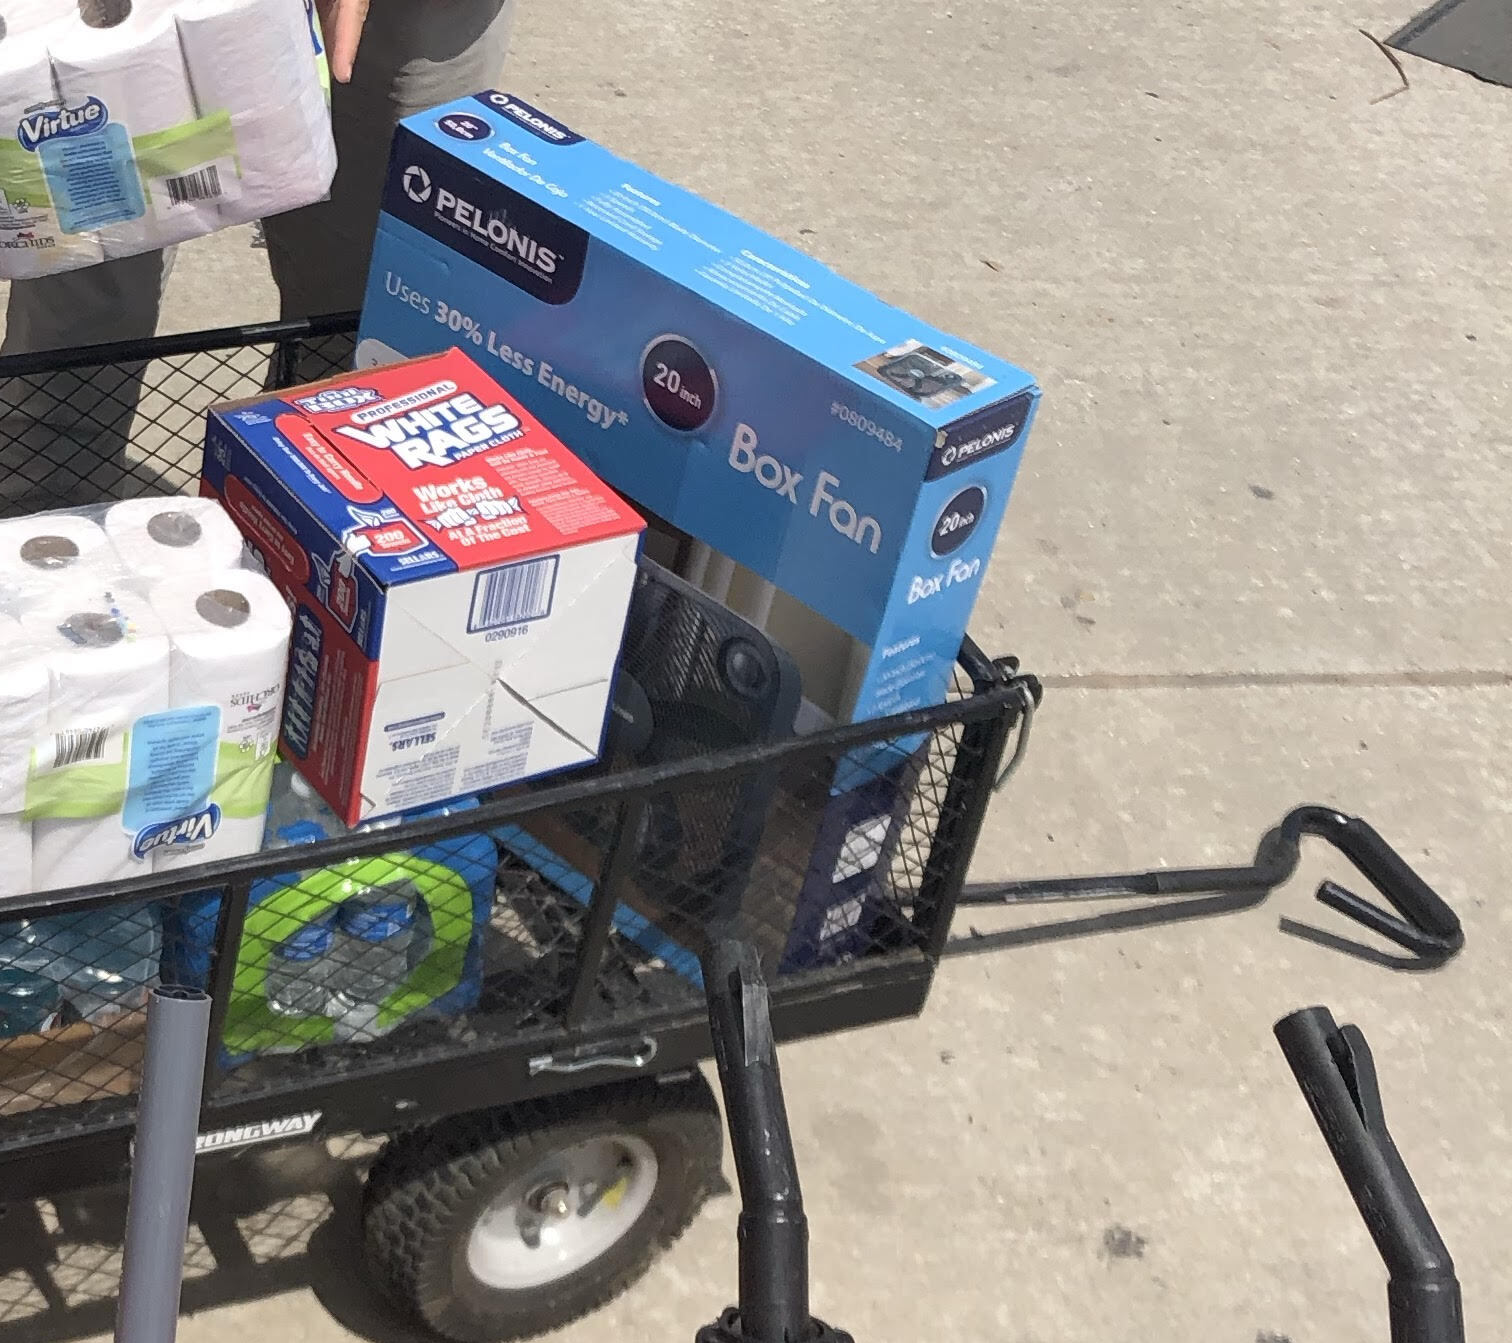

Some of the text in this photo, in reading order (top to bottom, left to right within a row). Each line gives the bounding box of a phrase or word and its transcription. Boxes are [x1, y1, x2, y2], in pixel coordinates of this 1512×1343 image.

[21, 105, 101, 143] Virtue
[505, 103, 567, 141] PELONIS
[436, 187, 557, 274] PELONIS
[385, 270, 432, 315] Uses
[434, 300, 484, 346] 30%
[487, 330, 536, 376] Less
[357, 383, 454, 422] PROFESSIONAL
[652, 361, 702, 410] 20 inch
[335, 392, 485, 449] WHITE
[391, 403, 521, 470] RAGS
[830, 399, 904, 453] #0809484
[453, 430, 524, 462] PAPER CLOTH
[958, 424, 1016, 459] PELONIS
[412, 475, 488, 504] Works
[419, 485, 504, 516] Like Cloth
[728, 422, 883, 555] Box Fan
[374, 529, 405, 546] 200
[475, 516, 528, 538] Fraction
[477, 531, 502, 545] The
[501, 523, 531, 541] Cost
[939, 512, 960, 536] 20
[398, 551, 440, 567] SELLARS
[907, 558, 981, 605] Box Fan
[391, 732, 436, 751] SELLARS
[139, 813, 213, 851] Virtue
[195, 1110, 323, 1147] RONGWAY
